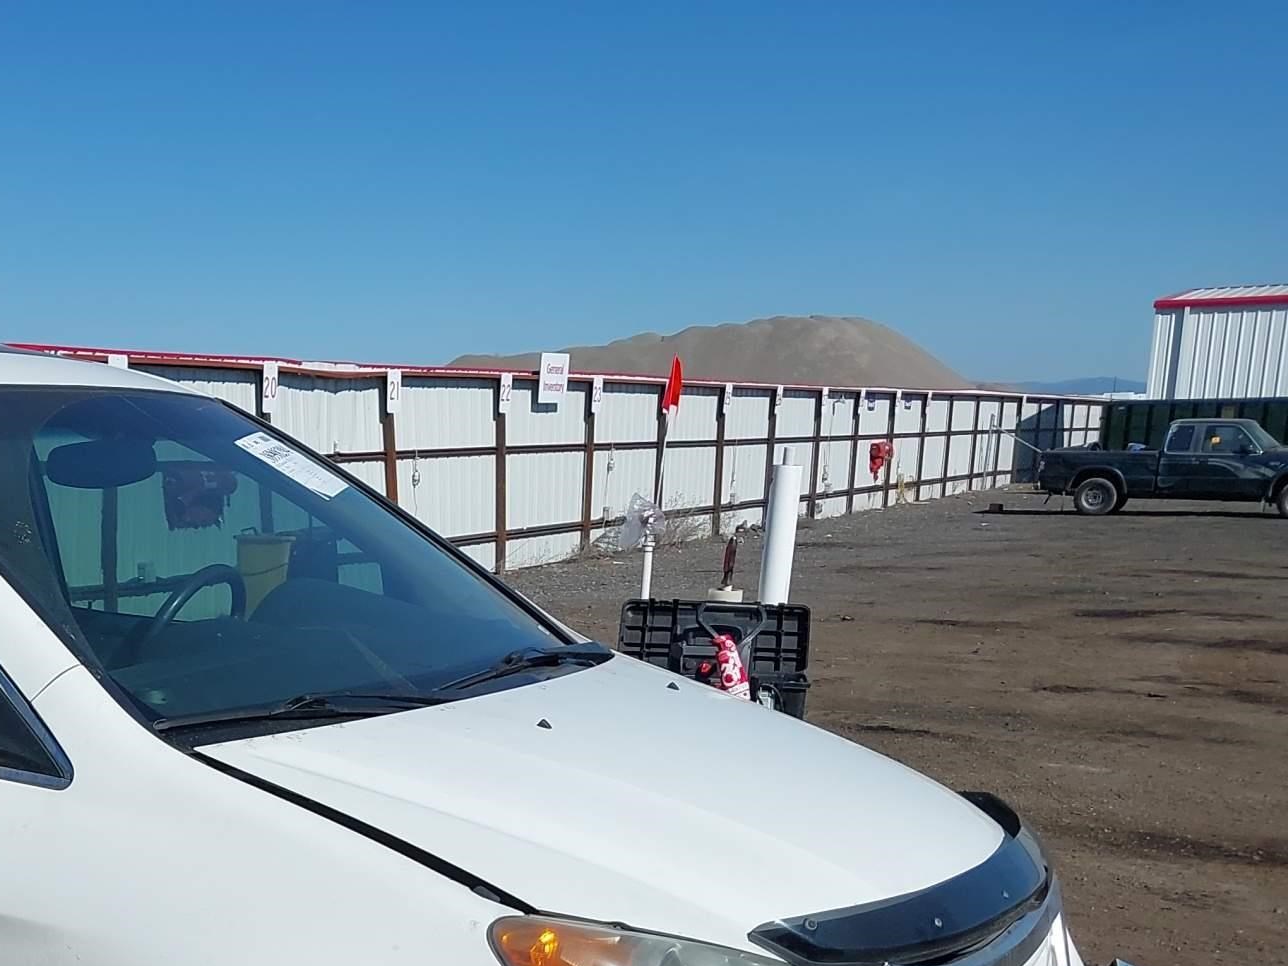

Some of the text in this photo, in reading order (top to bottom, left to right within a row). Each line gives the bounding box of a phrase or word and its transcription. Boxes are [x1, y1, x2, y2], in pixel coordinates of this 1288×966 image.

[547, 364, 563, 375] General
[264, 376, 277, 399] 20
[389, 381, 400, 400] 21
[500, 384, 511, 401] 22
[543, 381, 564, 393] Inventory
[593, 386, 601, 402] 23
